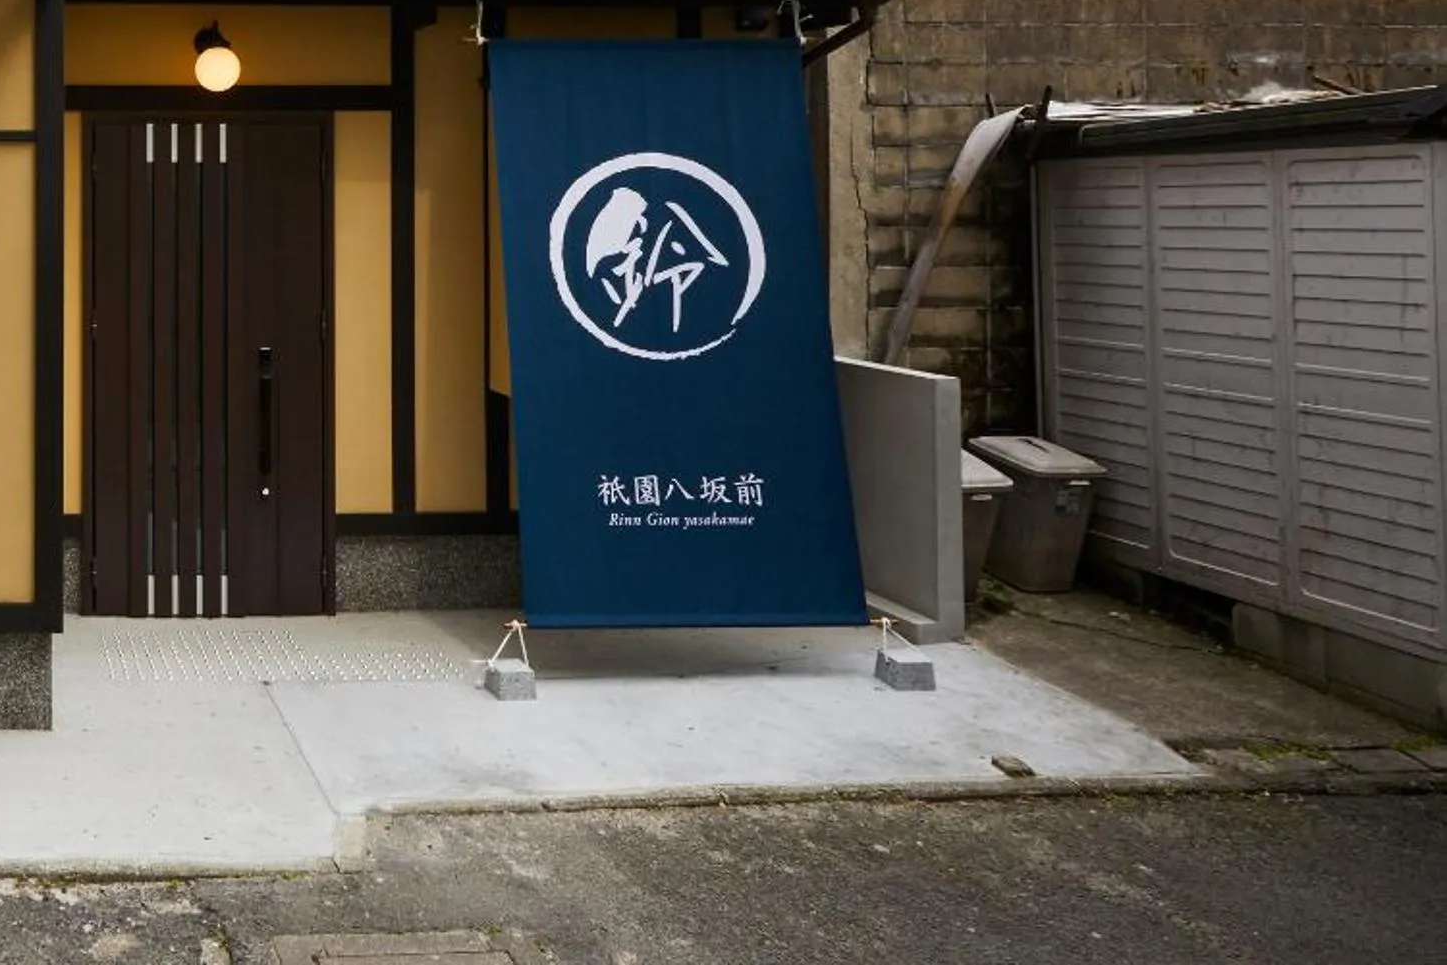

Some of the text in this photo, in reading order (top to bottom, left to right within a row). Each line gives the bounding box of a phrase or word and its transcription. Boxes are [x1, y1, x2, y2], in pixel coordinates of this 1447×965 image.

[597, 473, 765, 506] 祇園八坂前
[609, 510, 755, 530] Rinn Gion yasakamae
